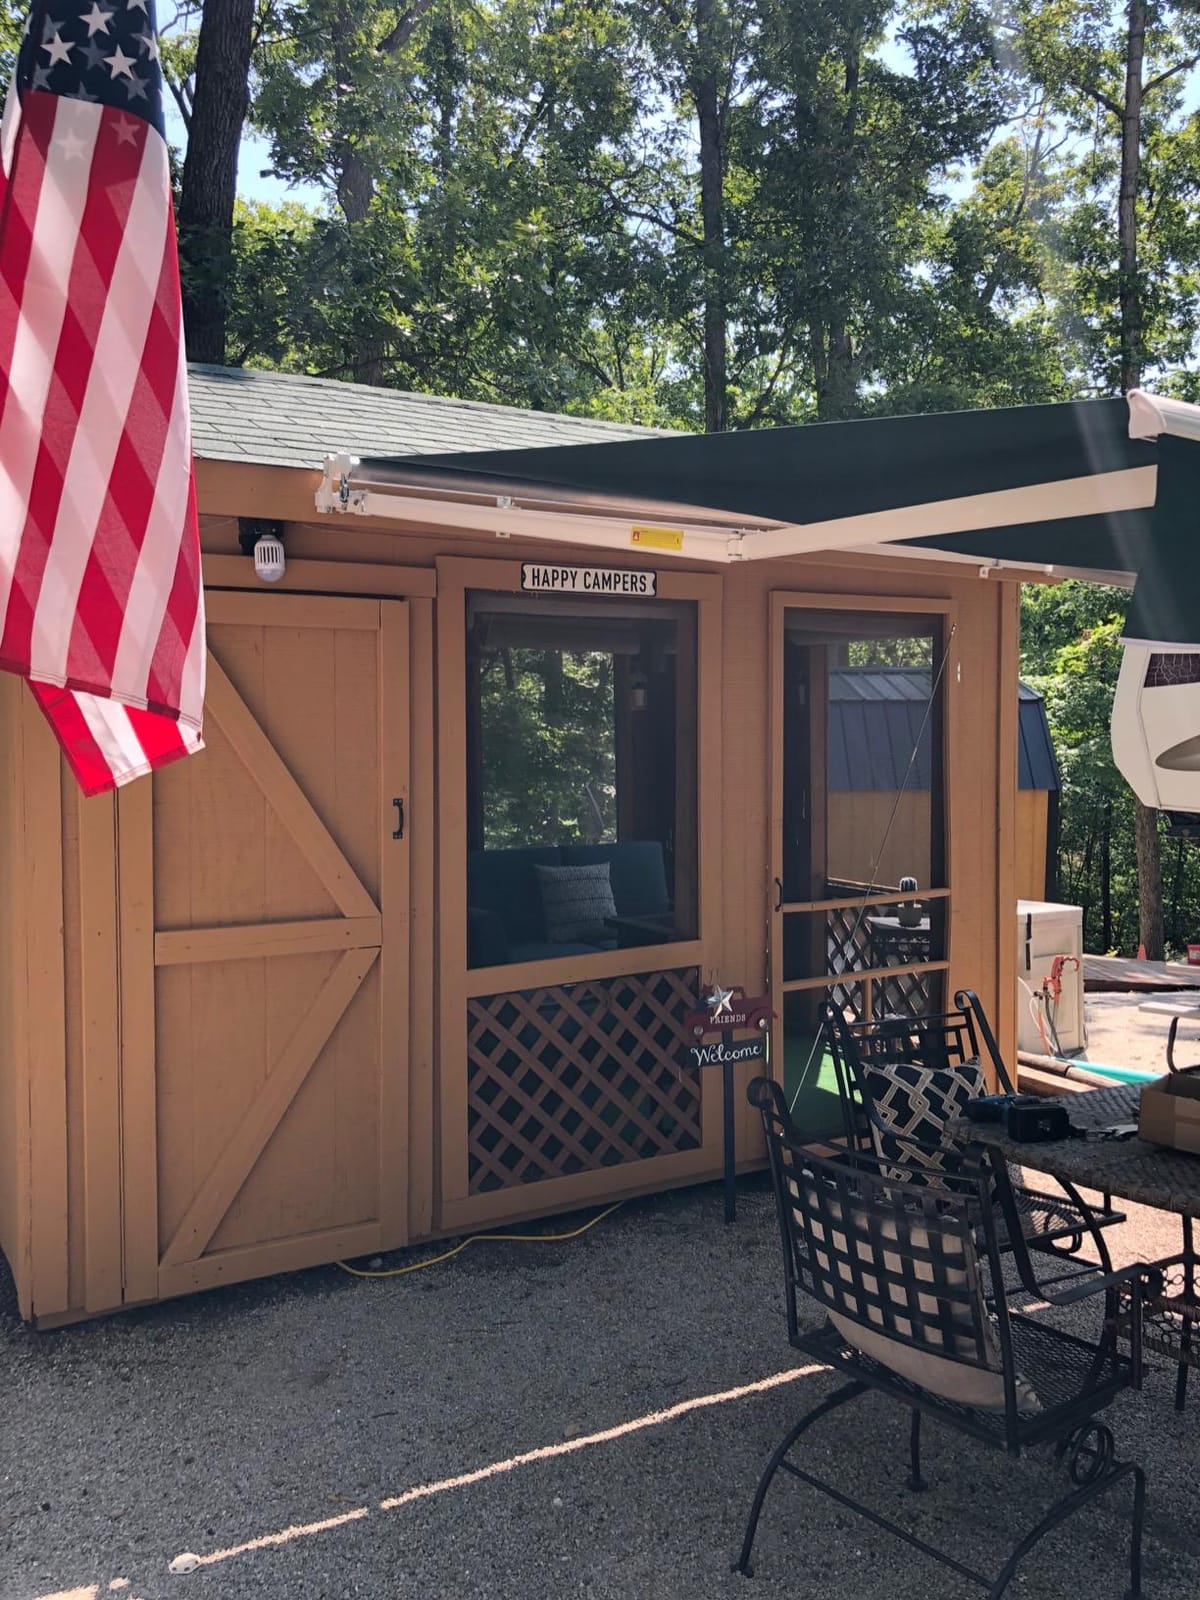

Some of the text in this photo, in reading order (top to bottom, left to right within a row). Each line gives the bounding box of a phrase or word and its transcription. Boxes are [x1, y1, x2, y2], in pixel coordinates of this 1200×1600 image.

[531, 567, 647, 593] HAPPY CAMPERS
[710, 1014, 746, 1024] FRIENDS
[690, 1043, 762, 1067] Welcome
